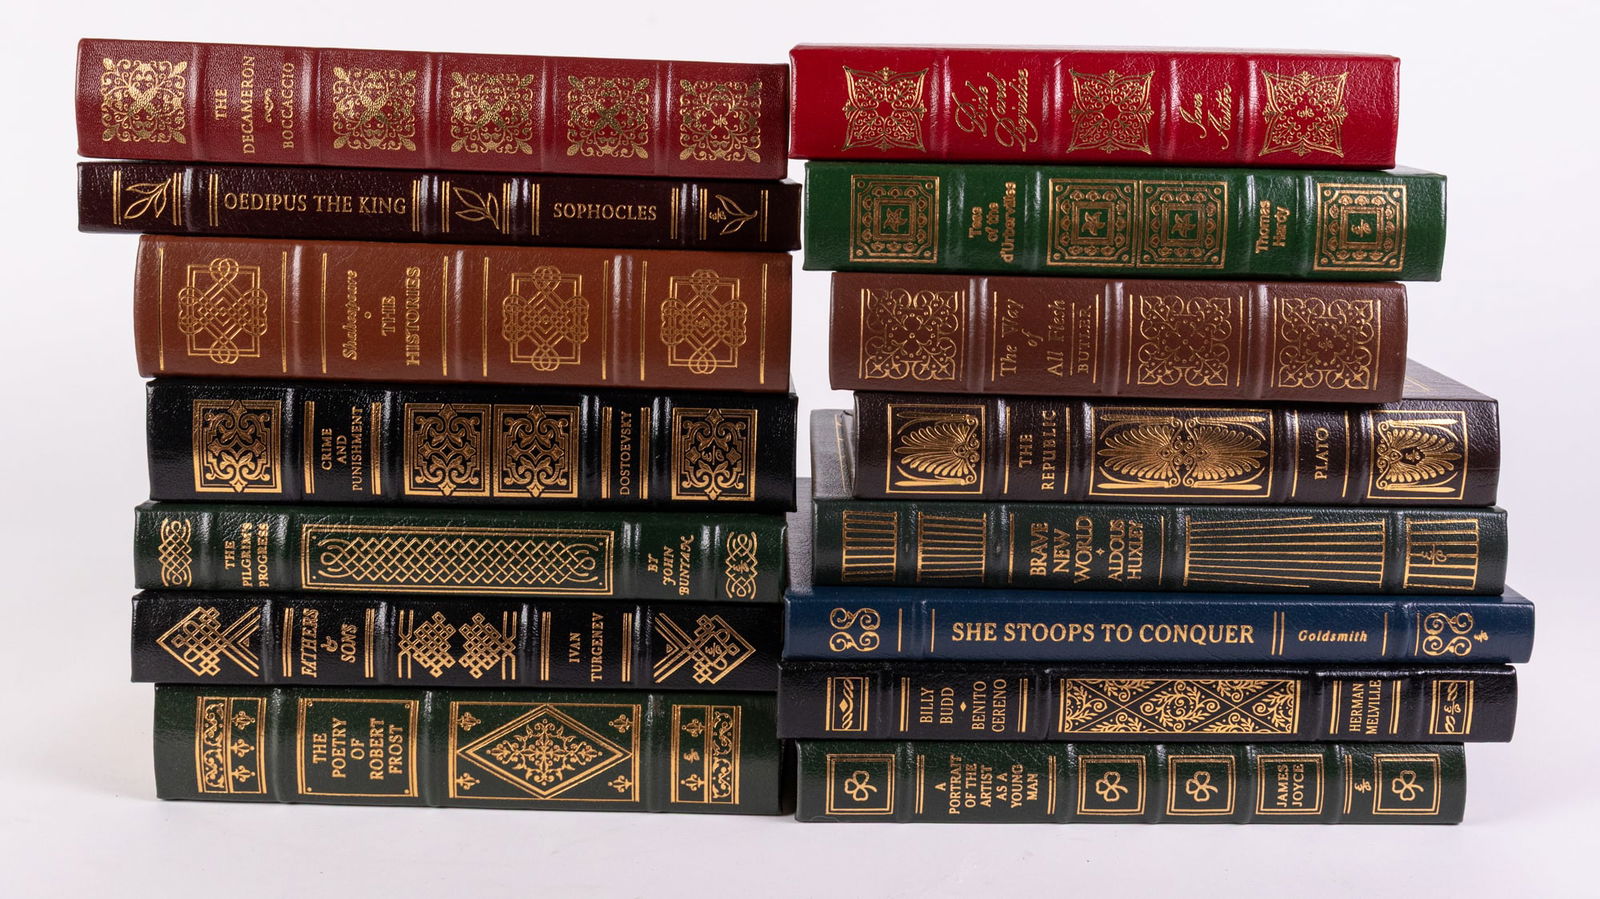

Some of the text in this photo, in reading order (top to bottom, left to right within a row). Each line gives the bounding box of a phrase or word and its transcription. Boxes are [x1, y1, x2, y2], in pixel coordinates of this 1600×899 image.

[215, 88, 227, 120] THE
[241, 55, 256, 154] DECAMERON
[282, 62, 295, 149] BOCCACCIO
[952, 80, 988, 137] Pride
[987, 71, 1006, 115] and
[990, 68, 1038, 152] Prejudice
[1179, 93, 1207, 139] Jane
[1208, 82, 1232, 150] Austen
[224, 192, 407, 215] OEDIPUS THE KING
[553, 203, 657, 221] SOPHOCLES
[968, 206, 982, 239] Tess
[985, 202, 999, 242] of the
[1000, 181, 1017, 263] d'Urbervilles
[1255, 200, 1271, 254] Thomas
[1273, 206, 1290, 247] Hardy
[342, 270, 360, 360] Shakespeare
[382, 296, 396, 337] THE
[405, 266, 421, 366] HISTORIES
[1000, 298, 1024, 377] The Way
[1022, 328, 1043, 347] of
[1046, 299, 1066, 377] All Flesh
[1078, 305, 1091, 374] BUTLER
[321, 427, 332, 471] CRIME
[336, 435, 347, 464] AND
[351, 405, 363, 491] PUNISHMENT
[620, 411, 632, 495] DOSTOEVSKY
[1019, 434, 1033, 468] THE
[1041, 410, 1056, 490] REPUBLIC
[1315, 427, 1329, 480] PLATO
[224, 541, 235, 569] THE
[258, 523, 269, 588] PROGRESS
[647, 553, 659, 573] BY
[663, 545, 676, 586] JOHN
[679, 534, 694, 596] BUNYAN
[1030, 522, 1048, 577] BRAVE
[1053, 528, 1071, 573] NEW
[1073, 515, 1093, 584] WORLD
[1108, 519, 1125, 582] ALDOUS
[1127, 520, 1144, 580] HUXLEY
[301, 608, 319, 678] FATHERS
[321, 636, 338, 653] &
[341, 623, 357, 663] SONS
[569, 632, 581, 663] IVAN
[591, 612, 604, 682] TURGENEV
[952, 622, 1254, 646] SHE STOOPS TO CONQUER
[1298, 630, 1368, 642] Goldsmith
[920, 687, 934, 723] BILLY
[940, 687, 954, 724] BUDD
[972, 680, 987, 730] BENITO
[992, 679, 1007, 733] CERENO
[1349, 683, 1364, 732] HERMAN
[1366, 680, 1381, 734] MELVILLE
[313, 733, 327, 764] THE
[332, 717, 347, 778] POETRY
[351, 738, 365, 760] OF
[369, 717, 384, 780] ROBERT
[388, 724, 404, 774] FROST
[935, 782, 946, 792] A
[949, 755, 962, 814] PORTRAIT
[965, 763, 978, 808] OF THE
[980, 764, 993, 807] ARTIST
[996, 772, 1008, 802] AS A
[1011, 764, 1024, 808] YOUNG
[1027, 773, 1038, 801] MAN
[1277, 764, 1289, 808] JAMES
[1292, 763, 1304, 807] JOYCE
